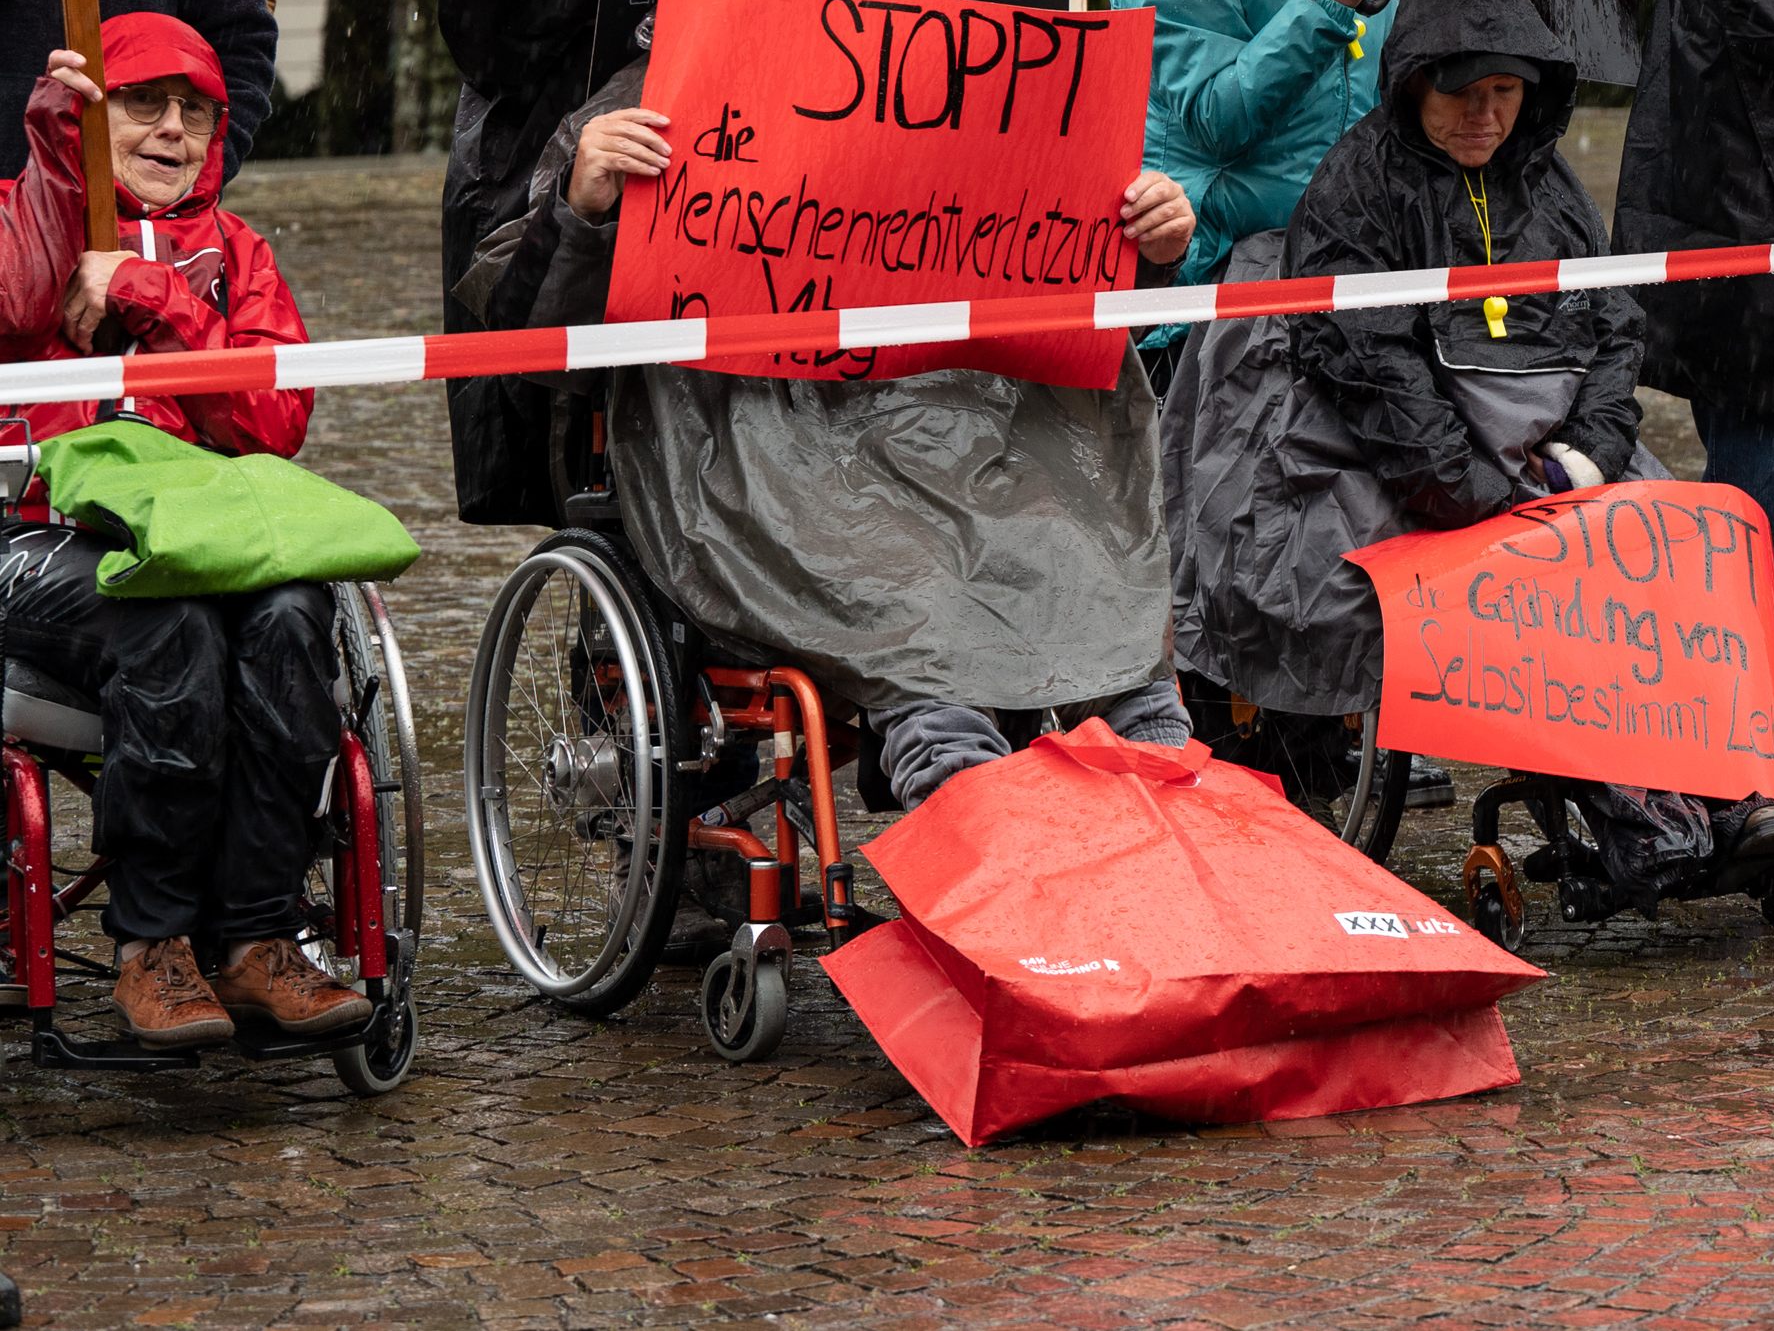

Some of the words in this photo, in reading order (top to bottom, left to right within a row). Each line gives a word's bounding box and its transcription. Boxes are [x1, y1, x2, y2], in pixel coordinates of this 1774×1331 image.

[693, 102, 759, 163] die
[1502, 498, 1759, 606] STOPPT
[1675, 620, 1749, 671] von
